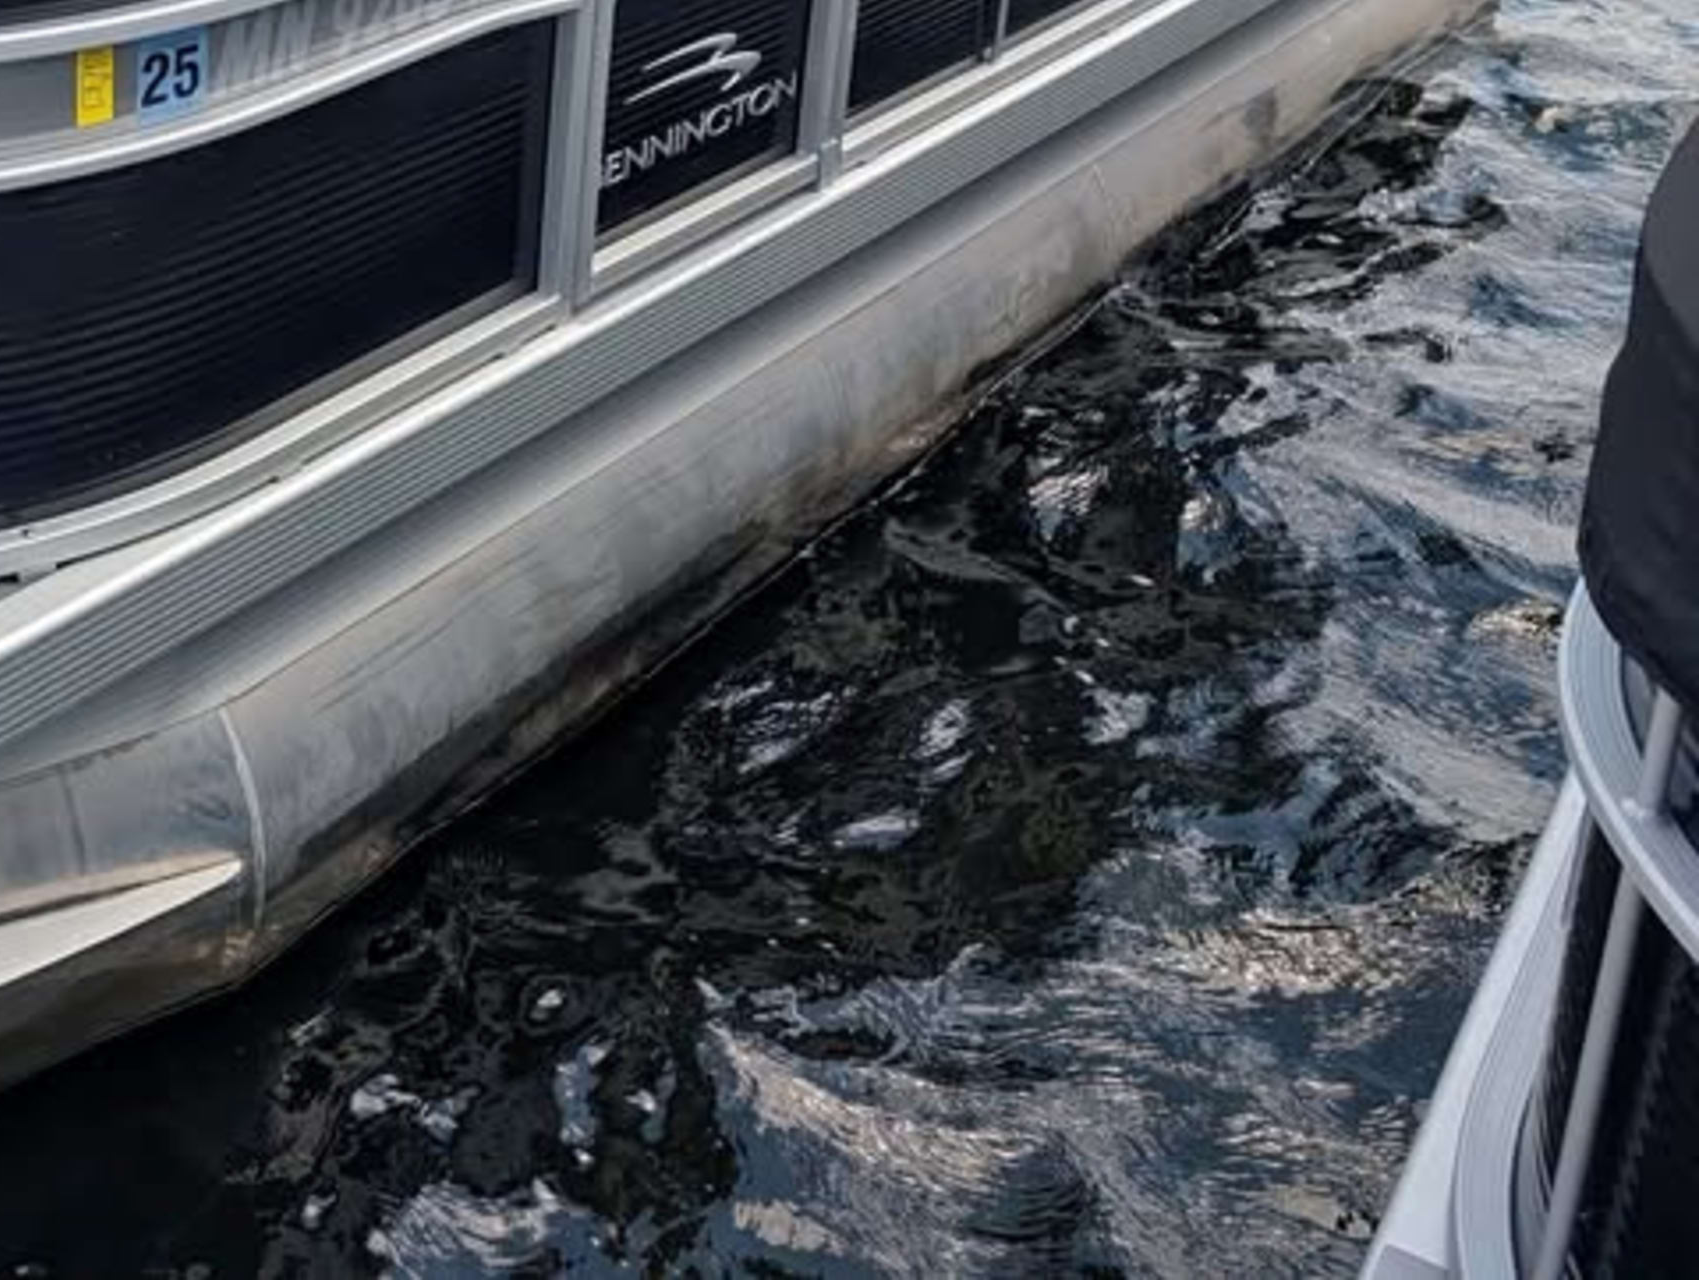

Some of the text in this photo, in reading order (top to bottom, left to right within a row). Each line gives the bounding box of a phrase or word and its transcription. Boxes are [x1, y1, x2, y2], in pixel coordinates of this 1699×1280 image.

[141, 43, 199, 108] 25
[214, 6, 317, 86] MN
[601, 72, 797, 186] ENNINGTON
